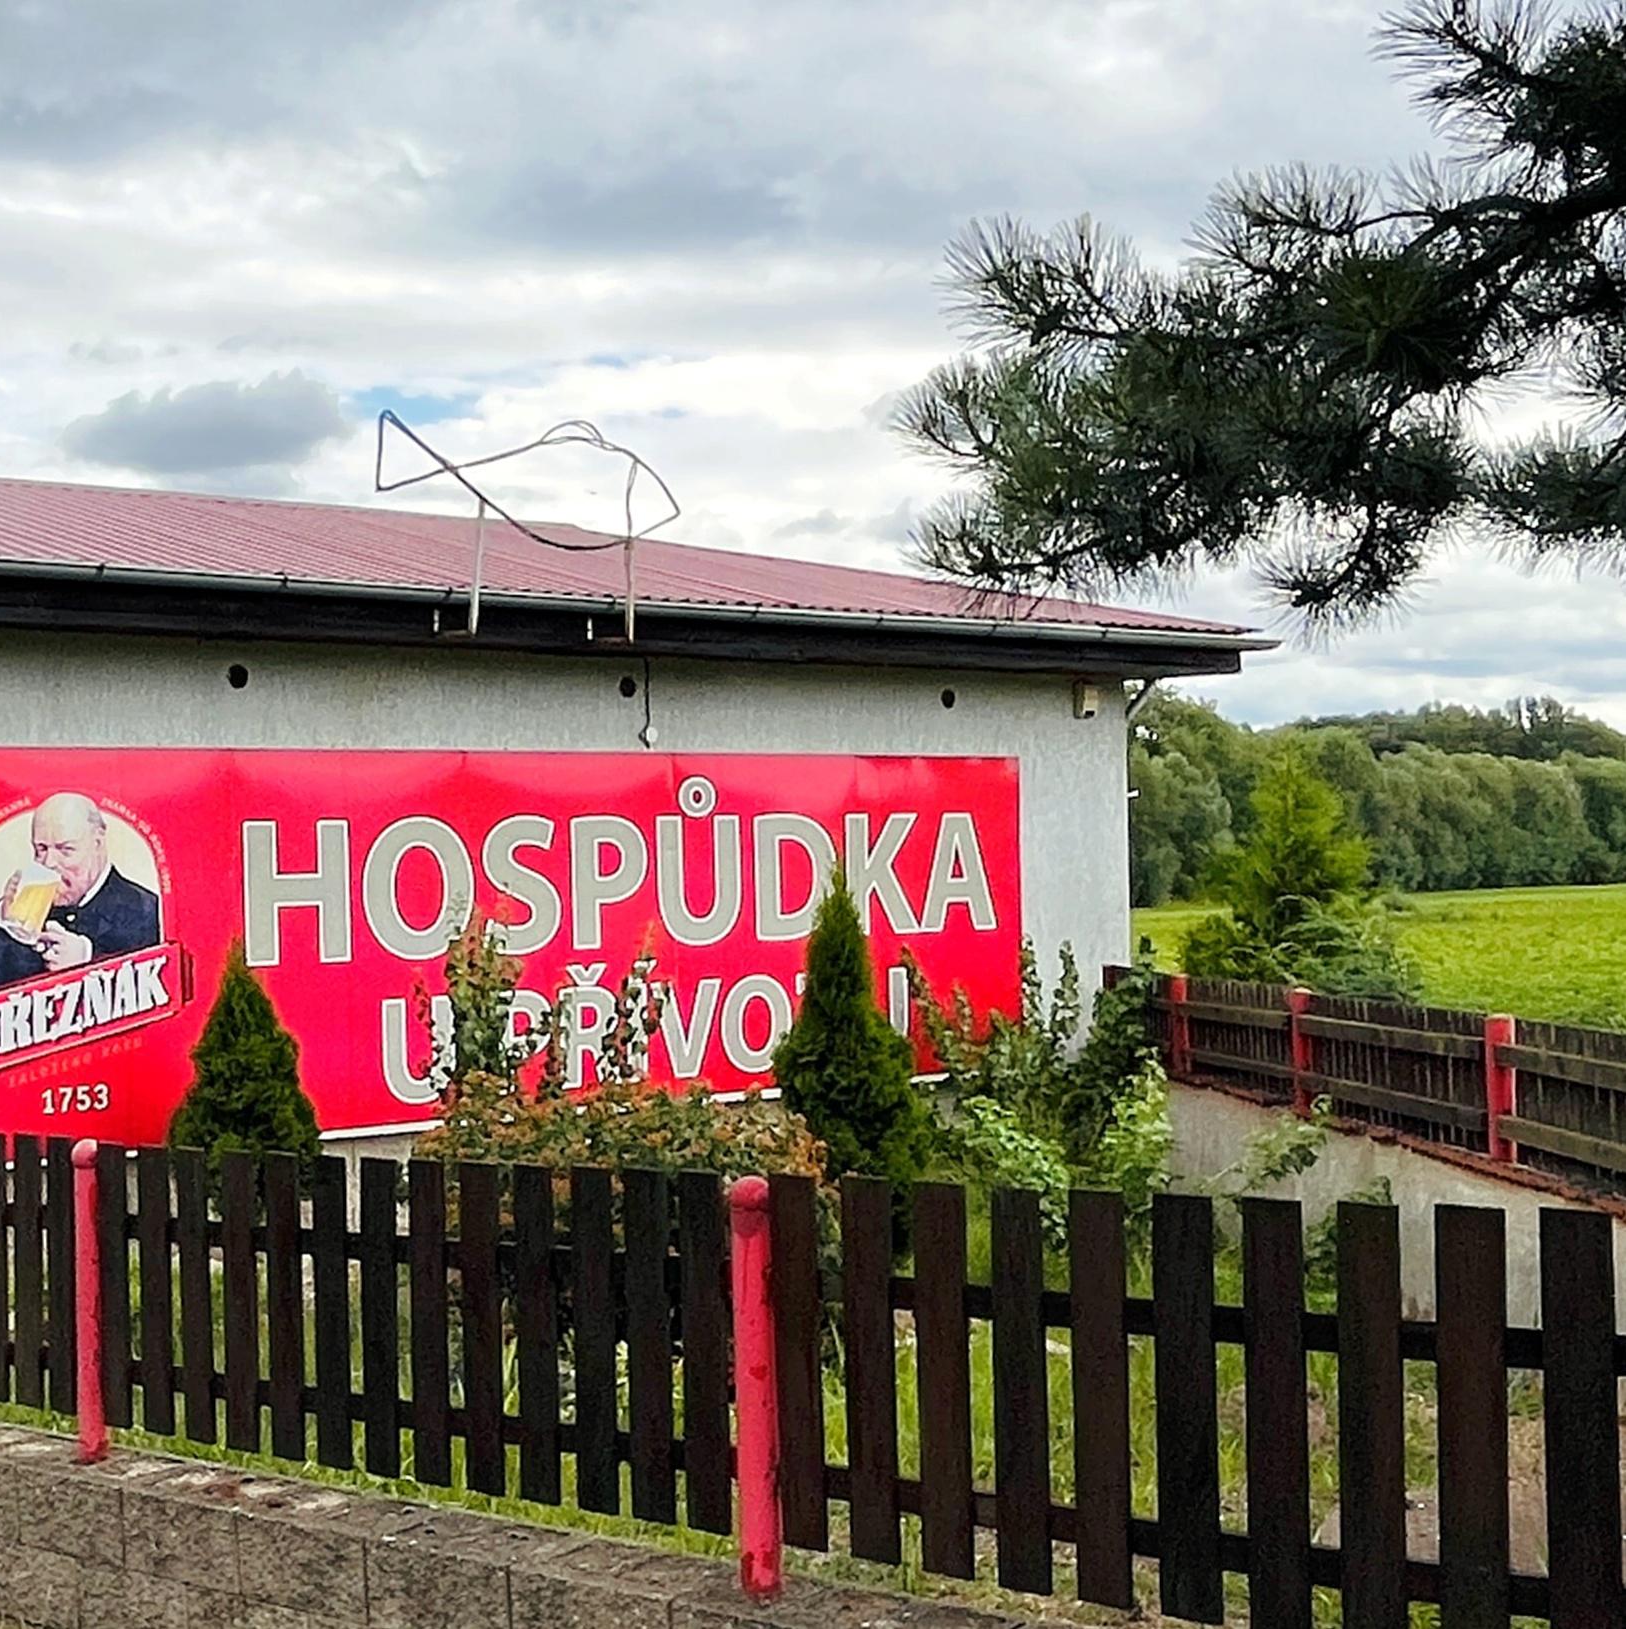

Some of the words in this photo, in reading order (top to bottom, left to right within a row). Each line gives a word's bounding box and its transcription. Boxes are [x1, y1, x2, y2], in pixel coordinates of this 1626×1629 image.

[241, 775, 999, 967] HOSPŮDKA
[41, 1083, 109, 1114] 1753
[380, 993, 456, 1105] U
[496, 958, 911, 1095] PŘÍVO
